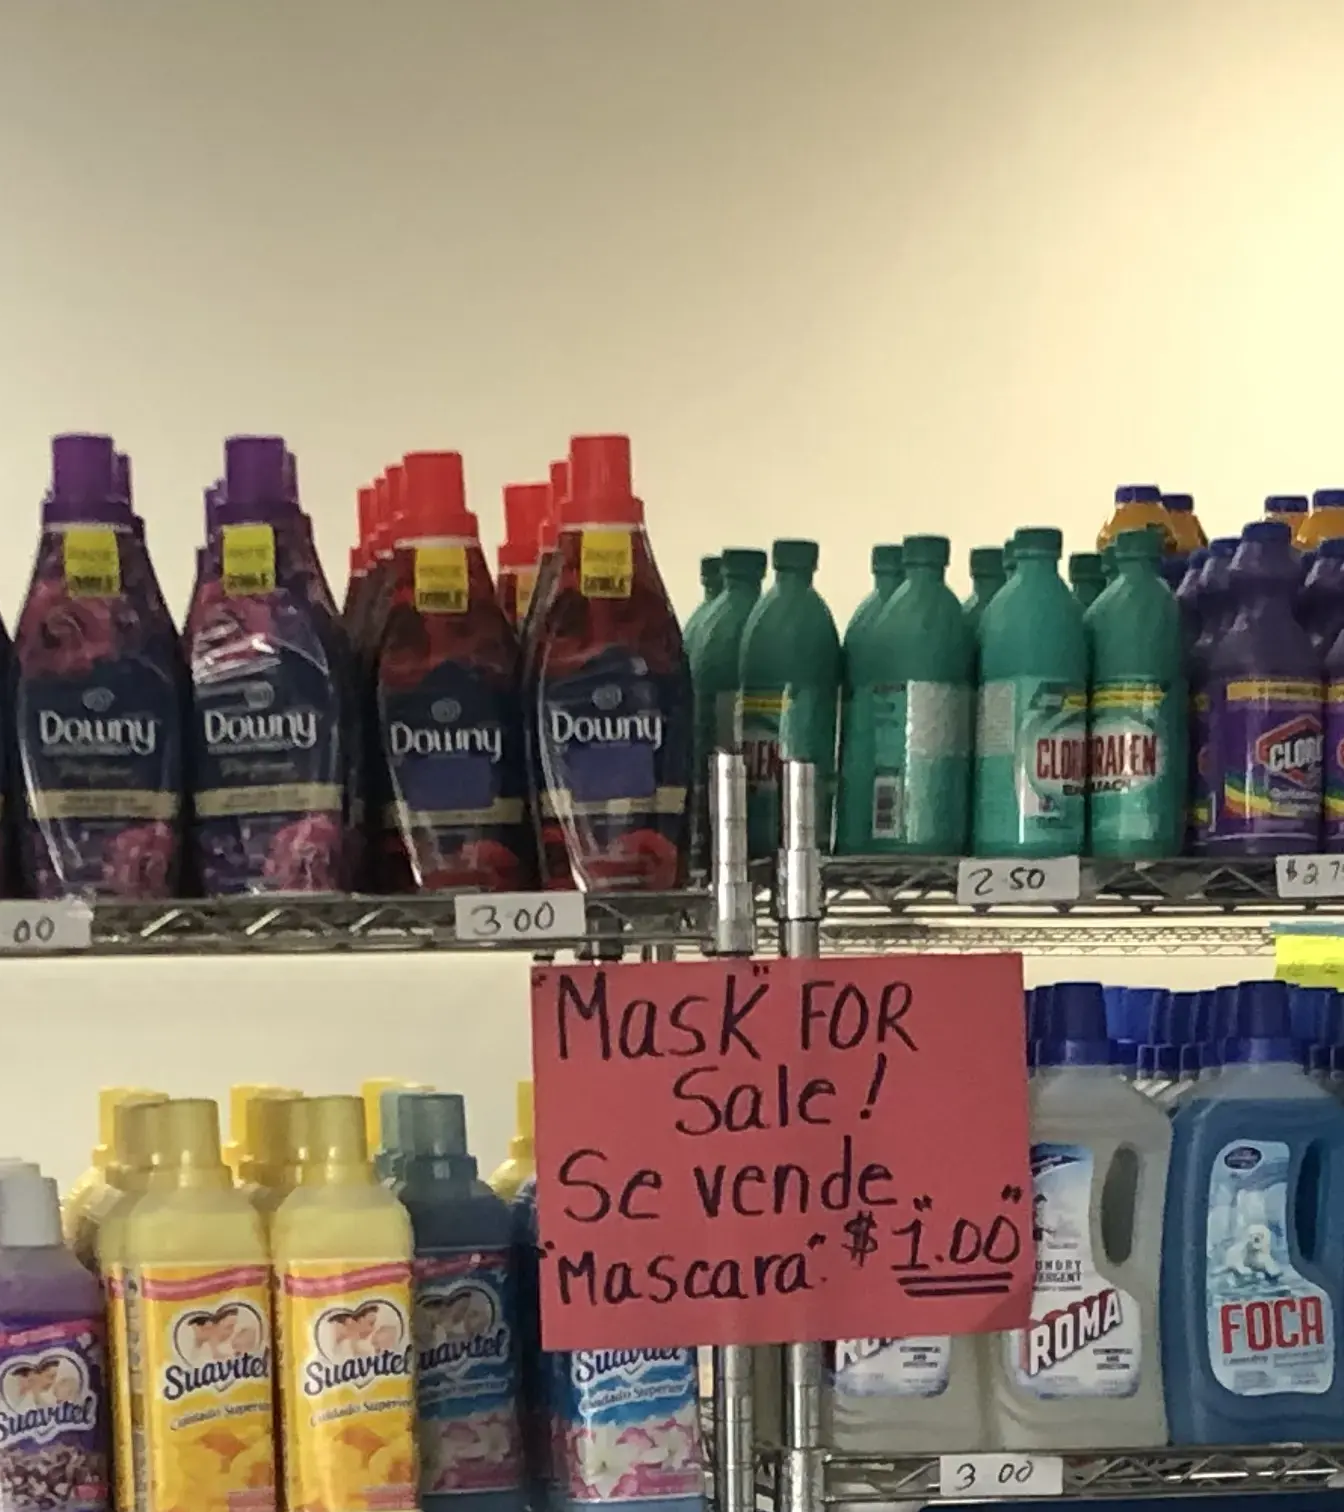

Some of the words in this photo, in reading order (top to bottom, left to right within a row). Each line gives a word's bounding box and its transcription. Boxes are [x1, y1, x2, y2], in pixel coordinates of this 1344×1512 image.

[39, 707, 157, 756] Downy
[203, 707, 319, 754] Downy
[389, 721, 504, 765] Downy
[549, 707, 663, 752] Downy
[800, 979, 919, 1053] FOR
[558, 1147, 664, 1223] Se
[692, 1134, 897, 1219] vende
[1027, 1287, 1125, 1378] ROMA
[1219, 1295, 1325, 1355] FOCA
[303, 1343, 414, 1398] Suavitel
[414, 1330, 506, 1376] uavitel
